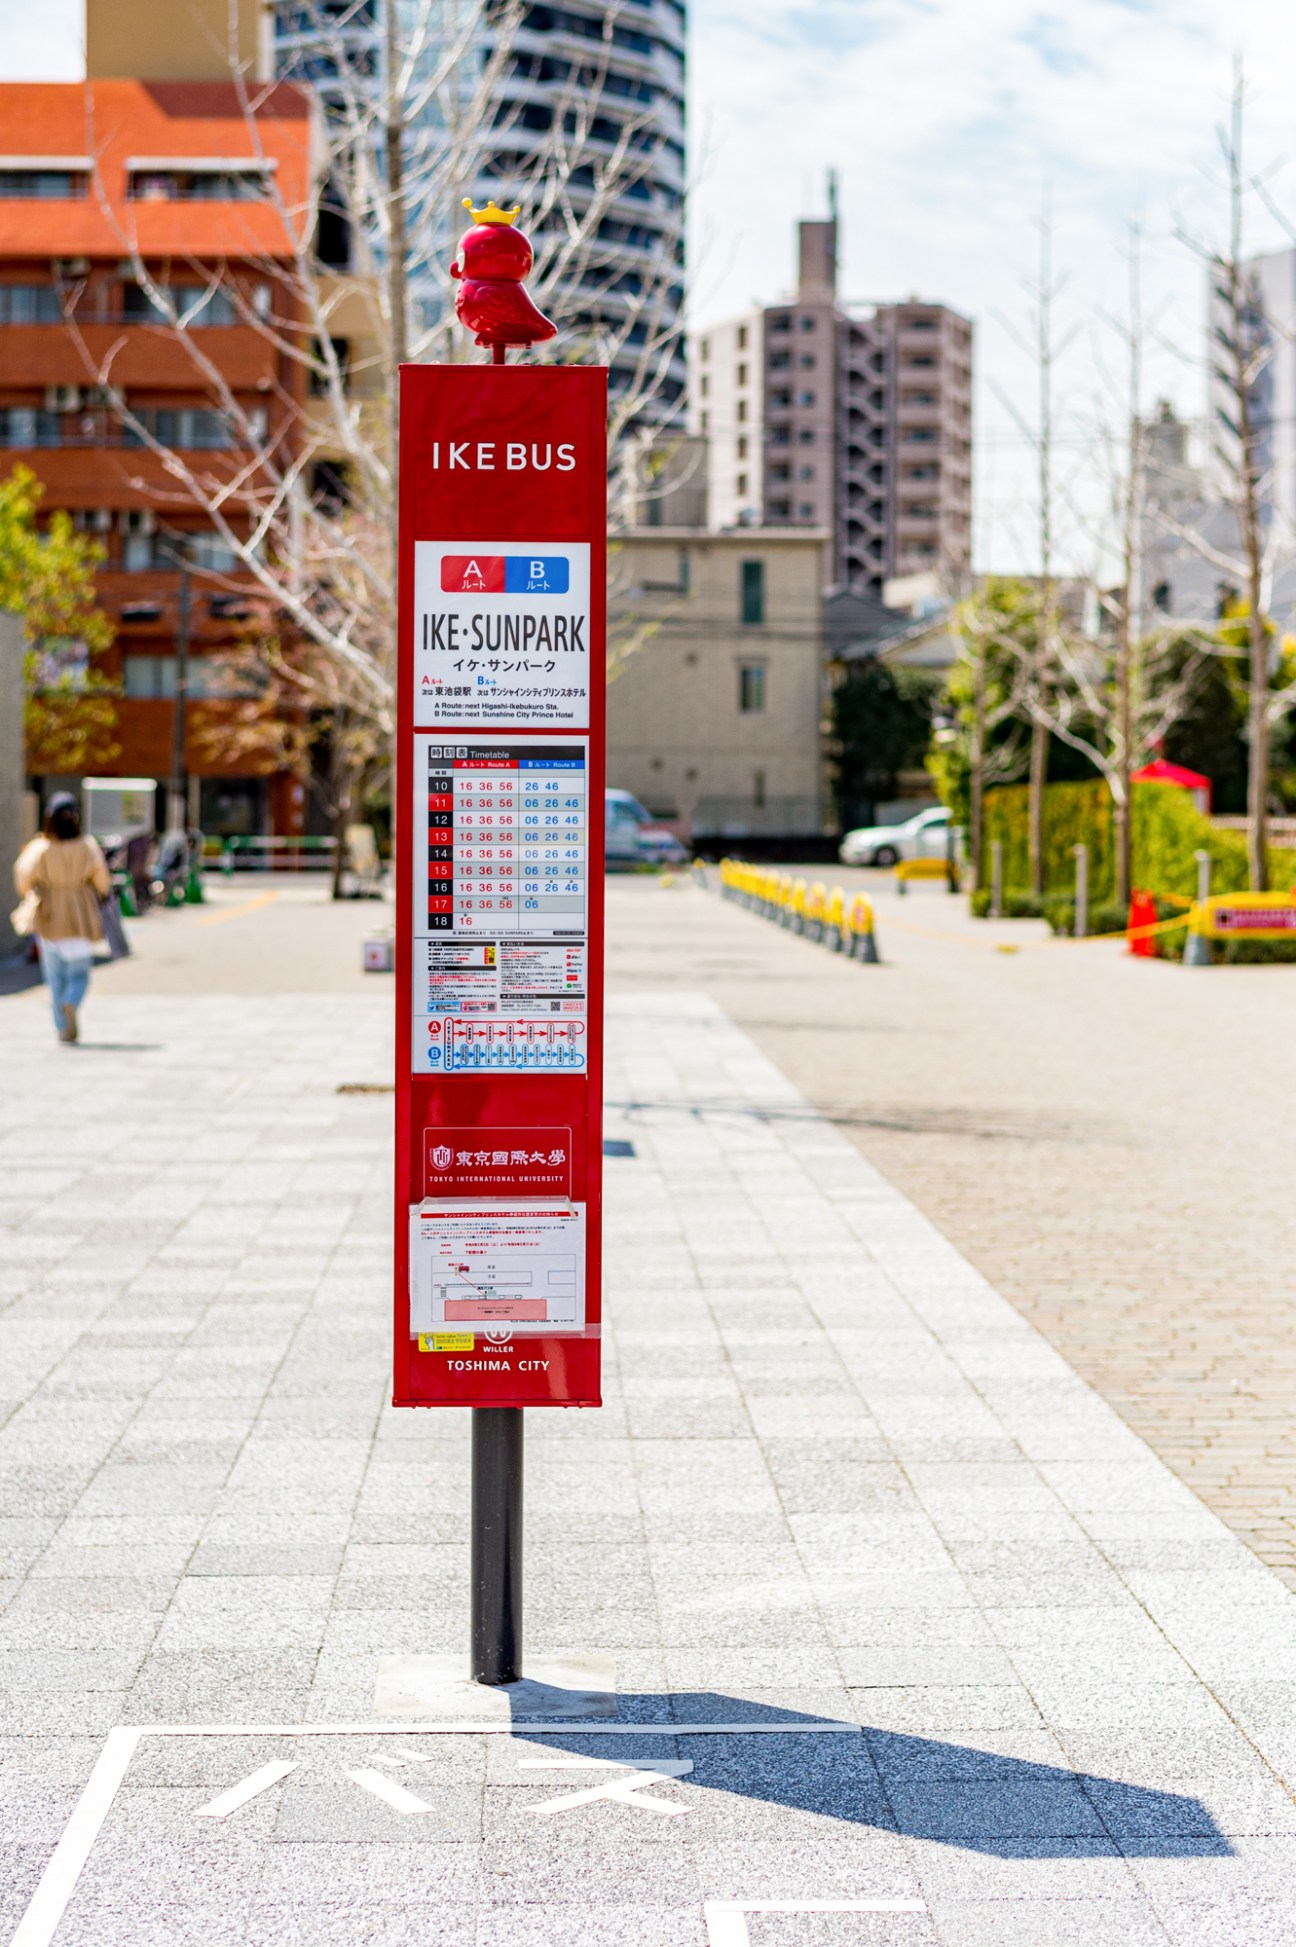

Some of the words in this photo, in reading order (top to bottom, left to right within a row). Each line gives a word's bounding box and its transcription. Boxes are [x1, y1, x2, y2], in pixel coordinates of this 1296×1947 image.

[433, 442, 496, 470] IKE
[506, 443, 576, 471] BUS
[463, 560, 483, 578] A
[530, 561, 545, 579] B
[462, 579, 486, 590] ルート
[526, 580, 550, 590] ルート
[481, 703, 544, 711] Higashi-Ikebukuro
[516, 711, 530, 719] City
[470, 750, 510, 759] Timetable
[434, 782, 448, 791] 10
[459, 782, 473, 791] 16
[479, 782, 493, 791] 36
[499, 782, 513, 791] 56
[525, 782, 539, 791] 26
[545, 782, 559, 791] 46
[434, 798, 448, 808] 11
[459, 798, 473, 808] 16
[479, 798, 493, 808] 36
[499, 798, 513, 808] 56
[525, 798, 539, 808] 06
[545, 798, 559, 808] 26
[565, 798, 579, 808] 46
[434, 815, 448, 825] 12
[459, 815, 473, 825] 16
[479, 815, 493, 825] 36
[499, 815, 513, 825] 56
[525, 815, 539, 825] 06
[545, 815, 559, 825] 26
[565, 815, 579, 825] 46
[434, 832, 448, 842] 13
[459, 832, 473, 842] 16
[479, 832, 493, 842] 36
[499, 832, 513, 842] 56
[525, 832, 539, 842] 06
[545, 832, 559, 842] 26
[565, 832, 579, 842] 46
[434, 849, 448, 858] 14
[459, 849, 473, 858] 16
[479, 849, 493, 858] 36
[499, 849, 513, 858] 56
[525, 849, 539, 858] 06
[545, 849, 559, 858] 26
[565, 849, 579, 858] 46
[434, 866, 448, 875] 15
[459, 866, 473, 875] 16
[479, 866, 493, 875] 36
[499, 866, 513, 875] 56
[525, 866, 539, 875] 06
[545, 866, 559, 875] 26
[565, 866, 579, 875] 46
[434, 883, 448, 892] 16
[459, 883, 473, 892] 16
[479, 883, 493, 892] 36
[499, 883, 513, 892] 56
[525, 883, 539, 892] 06
[545, 883, 559, 892] 26
[565, 883, 579, 892] 46
[434, 900, 448, 909] 17
[459, 900, 473, 909] 16
[479, 900, 493, 909] 36
[499, 900, 513, 909] 56
[525, 900, 539, 909] 06
[434, 916, 448, 926] 18
[459, 916, 473, 926] 16
[430, 1022, 439, 1031] A
[431, 1049, 439, 1057] B
[429, 1175, 454, 1183] TOKYO
[456, 1175, 516, 1183] INTERNATIONAL
[519, 1175, 564, 1183] UNIVERSITY
[447, 1360, 511, 1371] TOSHIMA
[518, 1360, 550, 1371] CITY
